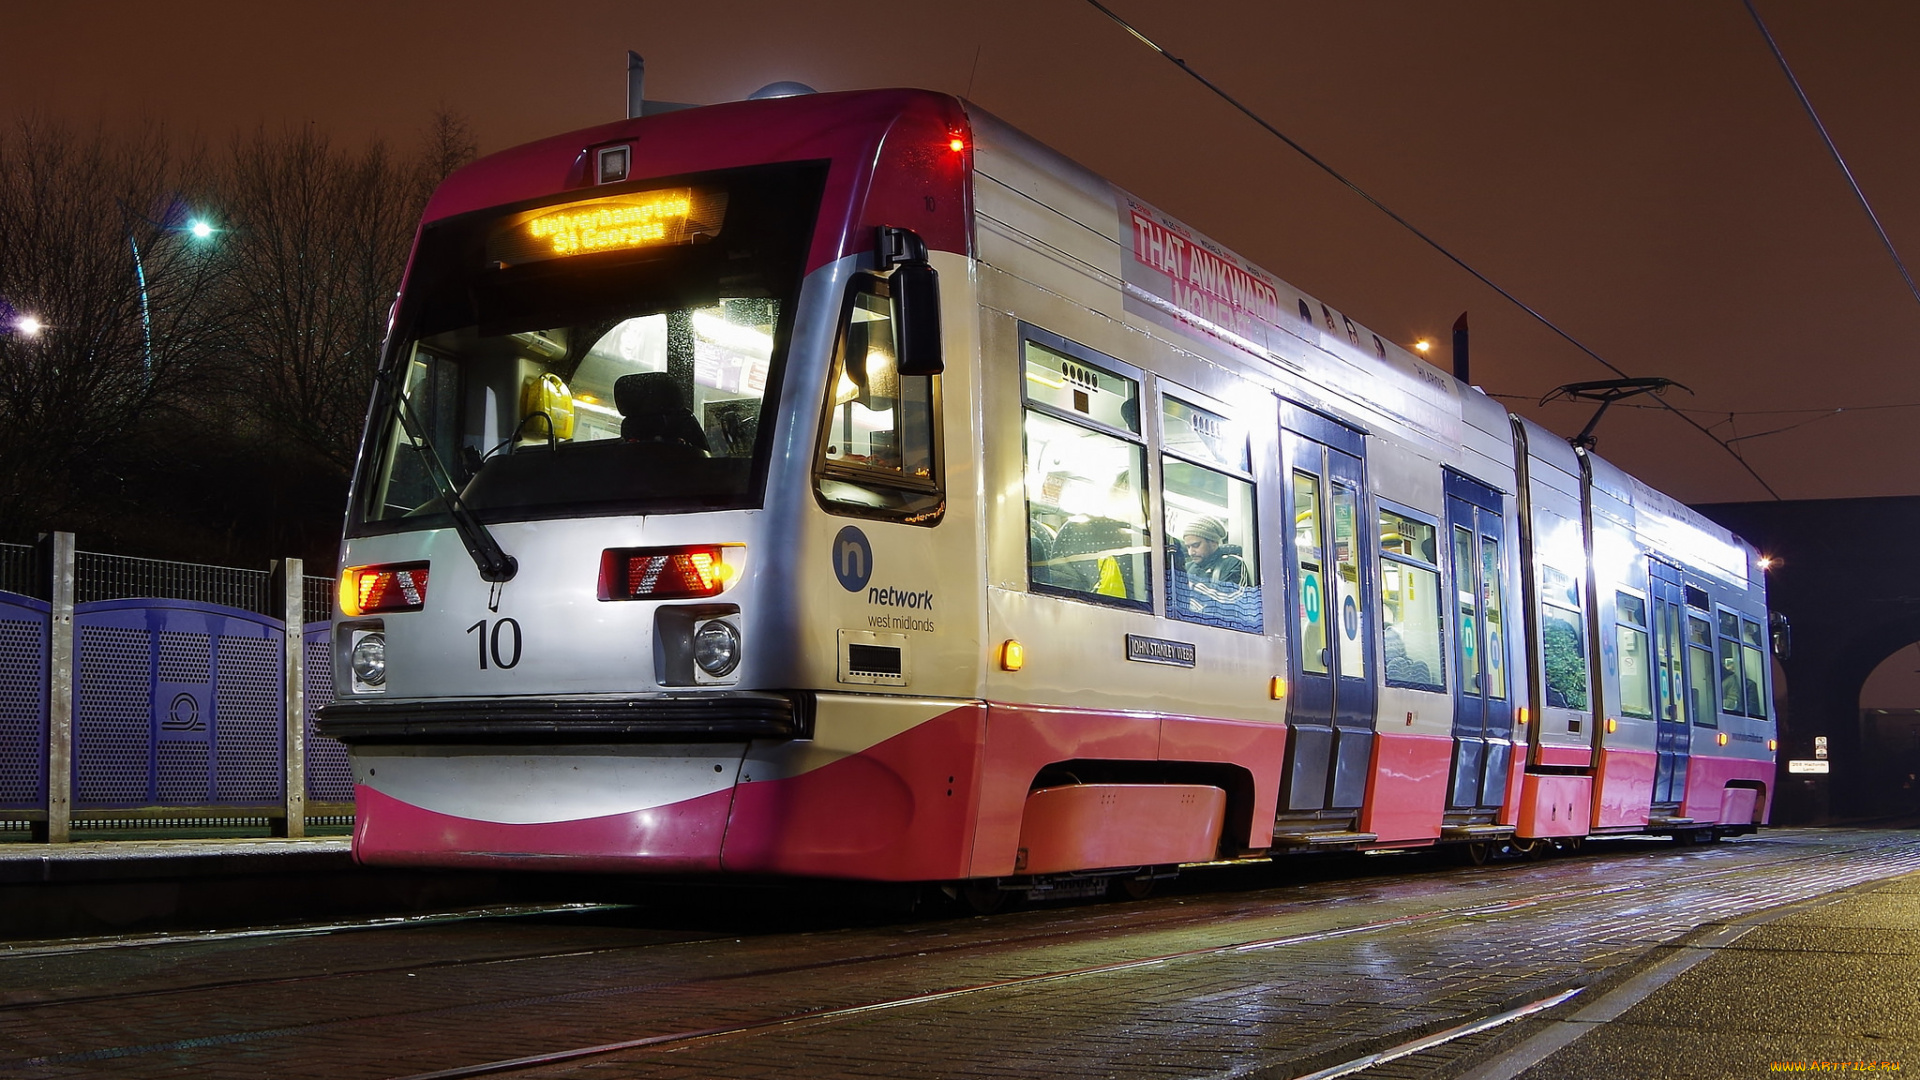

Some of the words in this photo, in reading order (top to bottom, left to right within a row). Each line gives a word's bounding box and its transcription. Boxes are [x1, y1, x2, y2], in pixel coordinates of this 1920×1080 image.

[923, 196, 936, 212] 10
[554, 232, 579, 252] St
[1133, 214, 1184, 280] THAT
[1189, 245, 1278, 324] AWKWARD
[868, 586, 933, 610] network
[868, 614, 890, 628] west
[893, 617, 934, 632] midlands
[466, 617, 522, 670] 10
[1131, 639, 1149, 656] JOHN
[1150, 642, 1175, 659] STANLEY
[1176, 647, 1194, 661] WEBB
